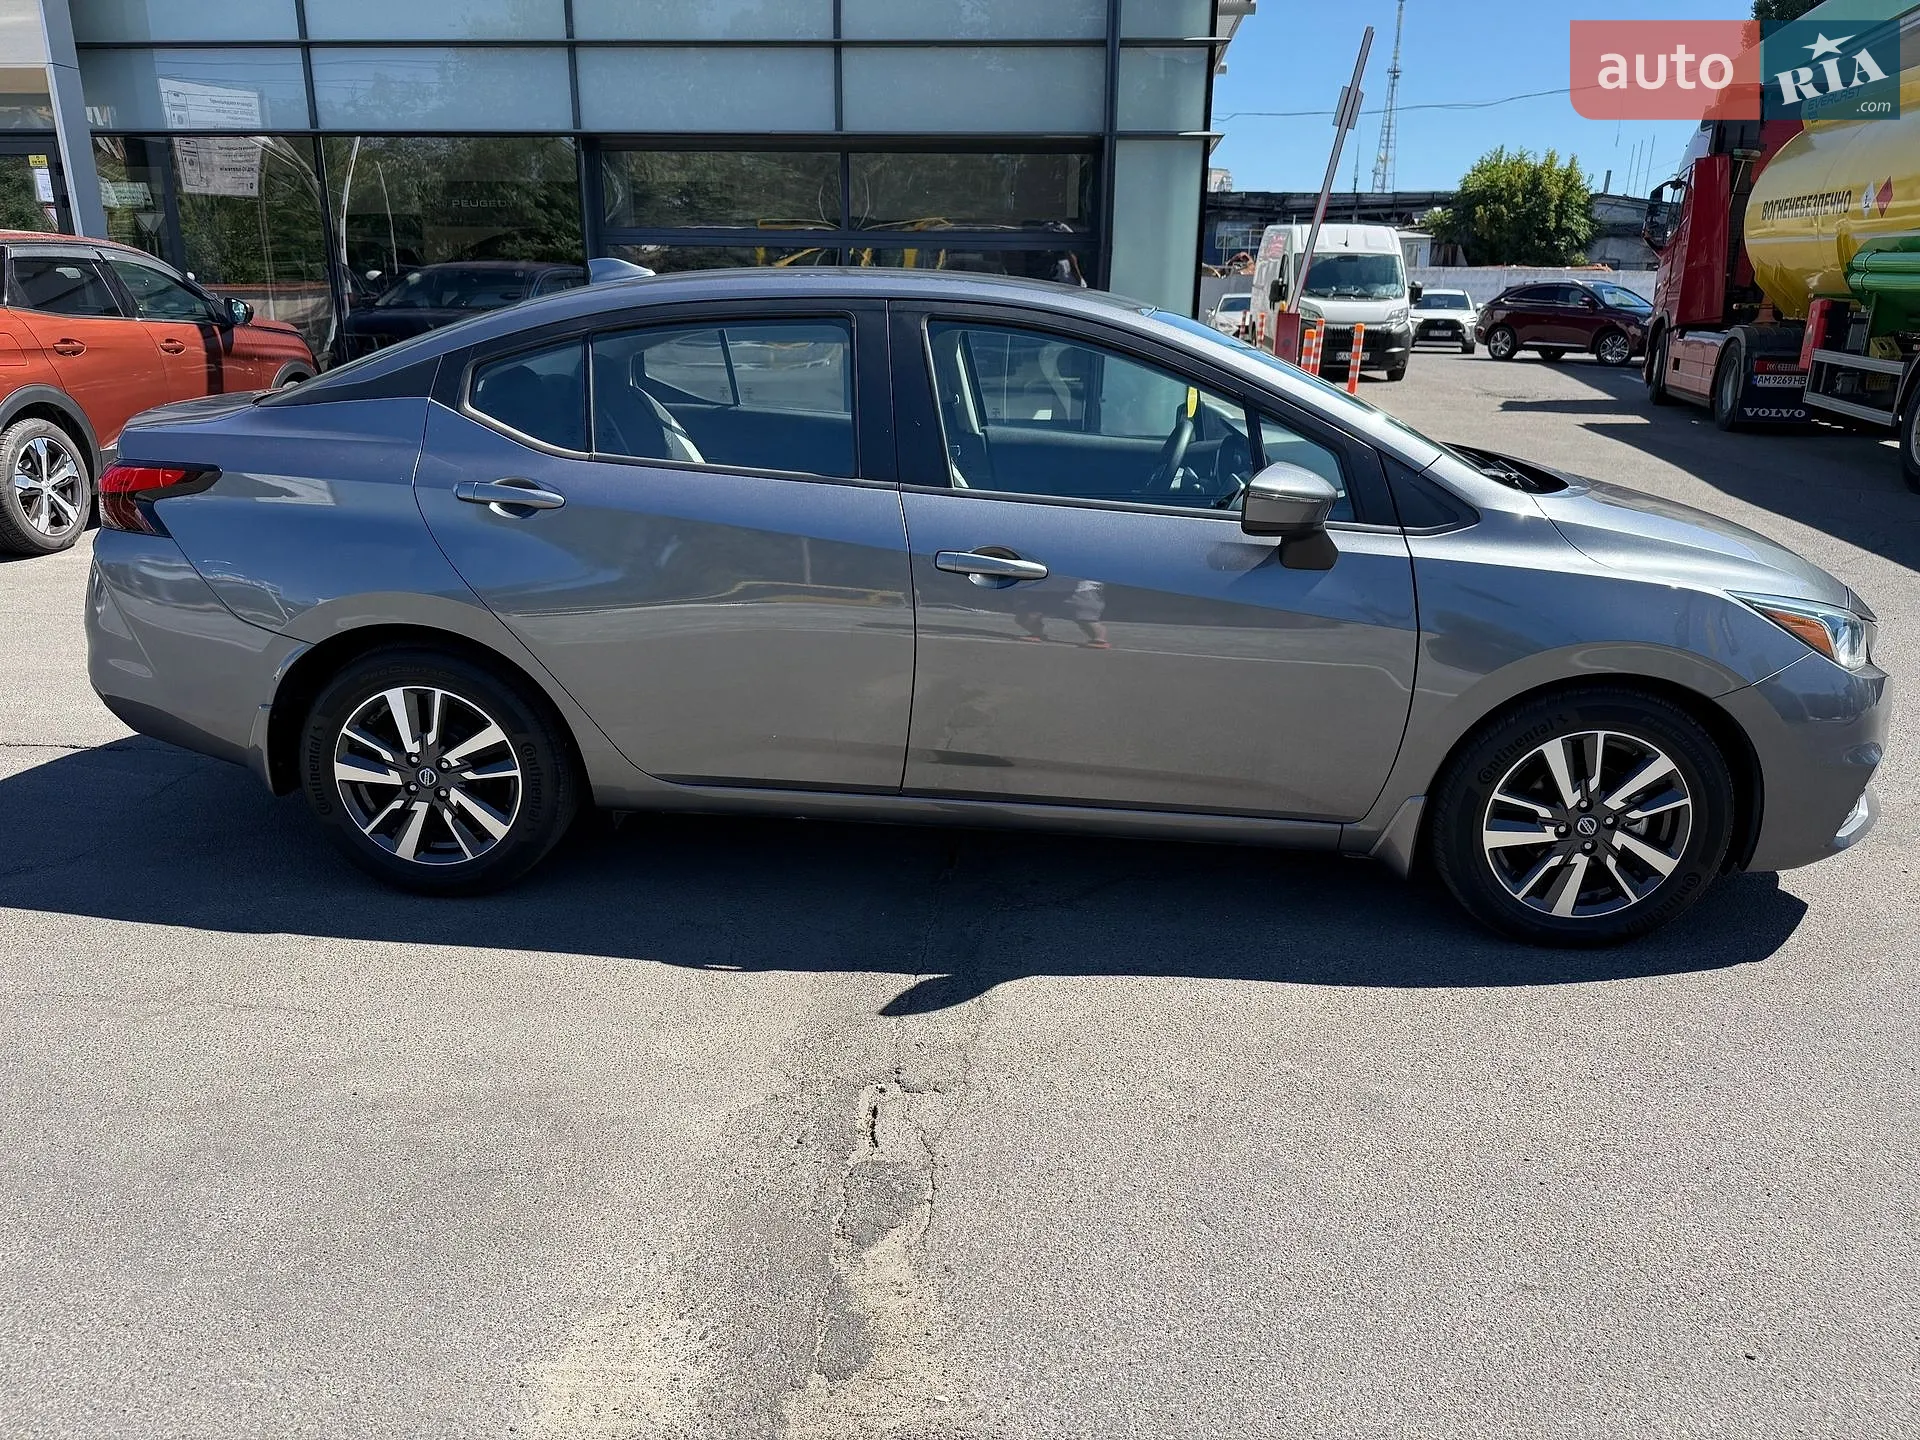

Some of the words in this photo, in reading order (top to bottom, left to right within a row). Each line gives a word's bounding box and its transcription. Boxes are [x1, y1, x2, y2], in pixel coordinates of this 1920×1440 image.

[1761, 189, 1852, 220] ВОГНЕНЕБЕЗПЕЧНО
[1743, 407, 1806, 418] VOLVO
[308, 734, 332, 815] Continental
[521, 742, 542, 823] Continental
[1478, 716, 1554, 784] Continental
